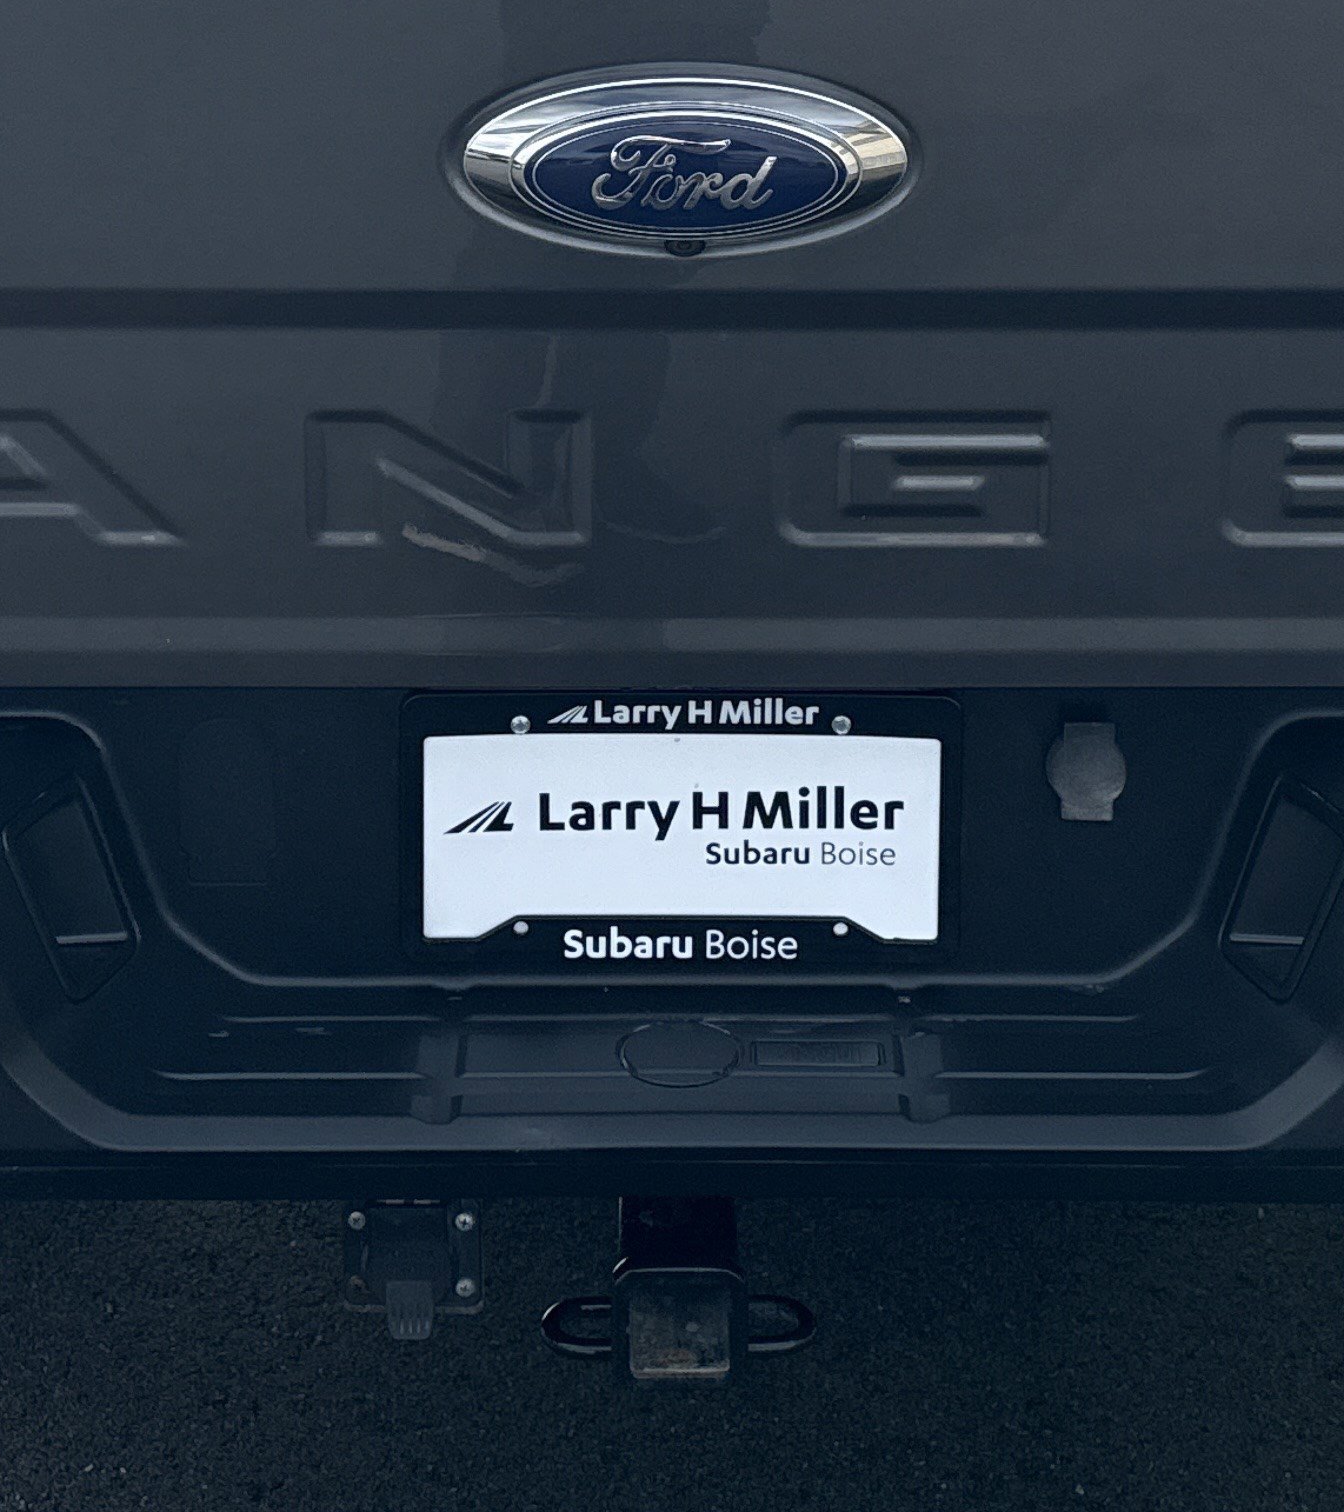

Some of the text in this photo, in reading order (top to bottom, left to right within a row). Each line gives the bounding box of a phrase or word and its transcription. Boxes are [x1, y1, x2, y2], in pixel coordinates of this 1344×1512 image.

[592, 134, 778, 210] Ford
[593, 697, 820, 730] Larry H Miller
[539, 785, 905, 841] Larry H Miller
[705, 840, 896, 866] Subaru Boise
[563, 926, 798, 960] Subaru Boise
